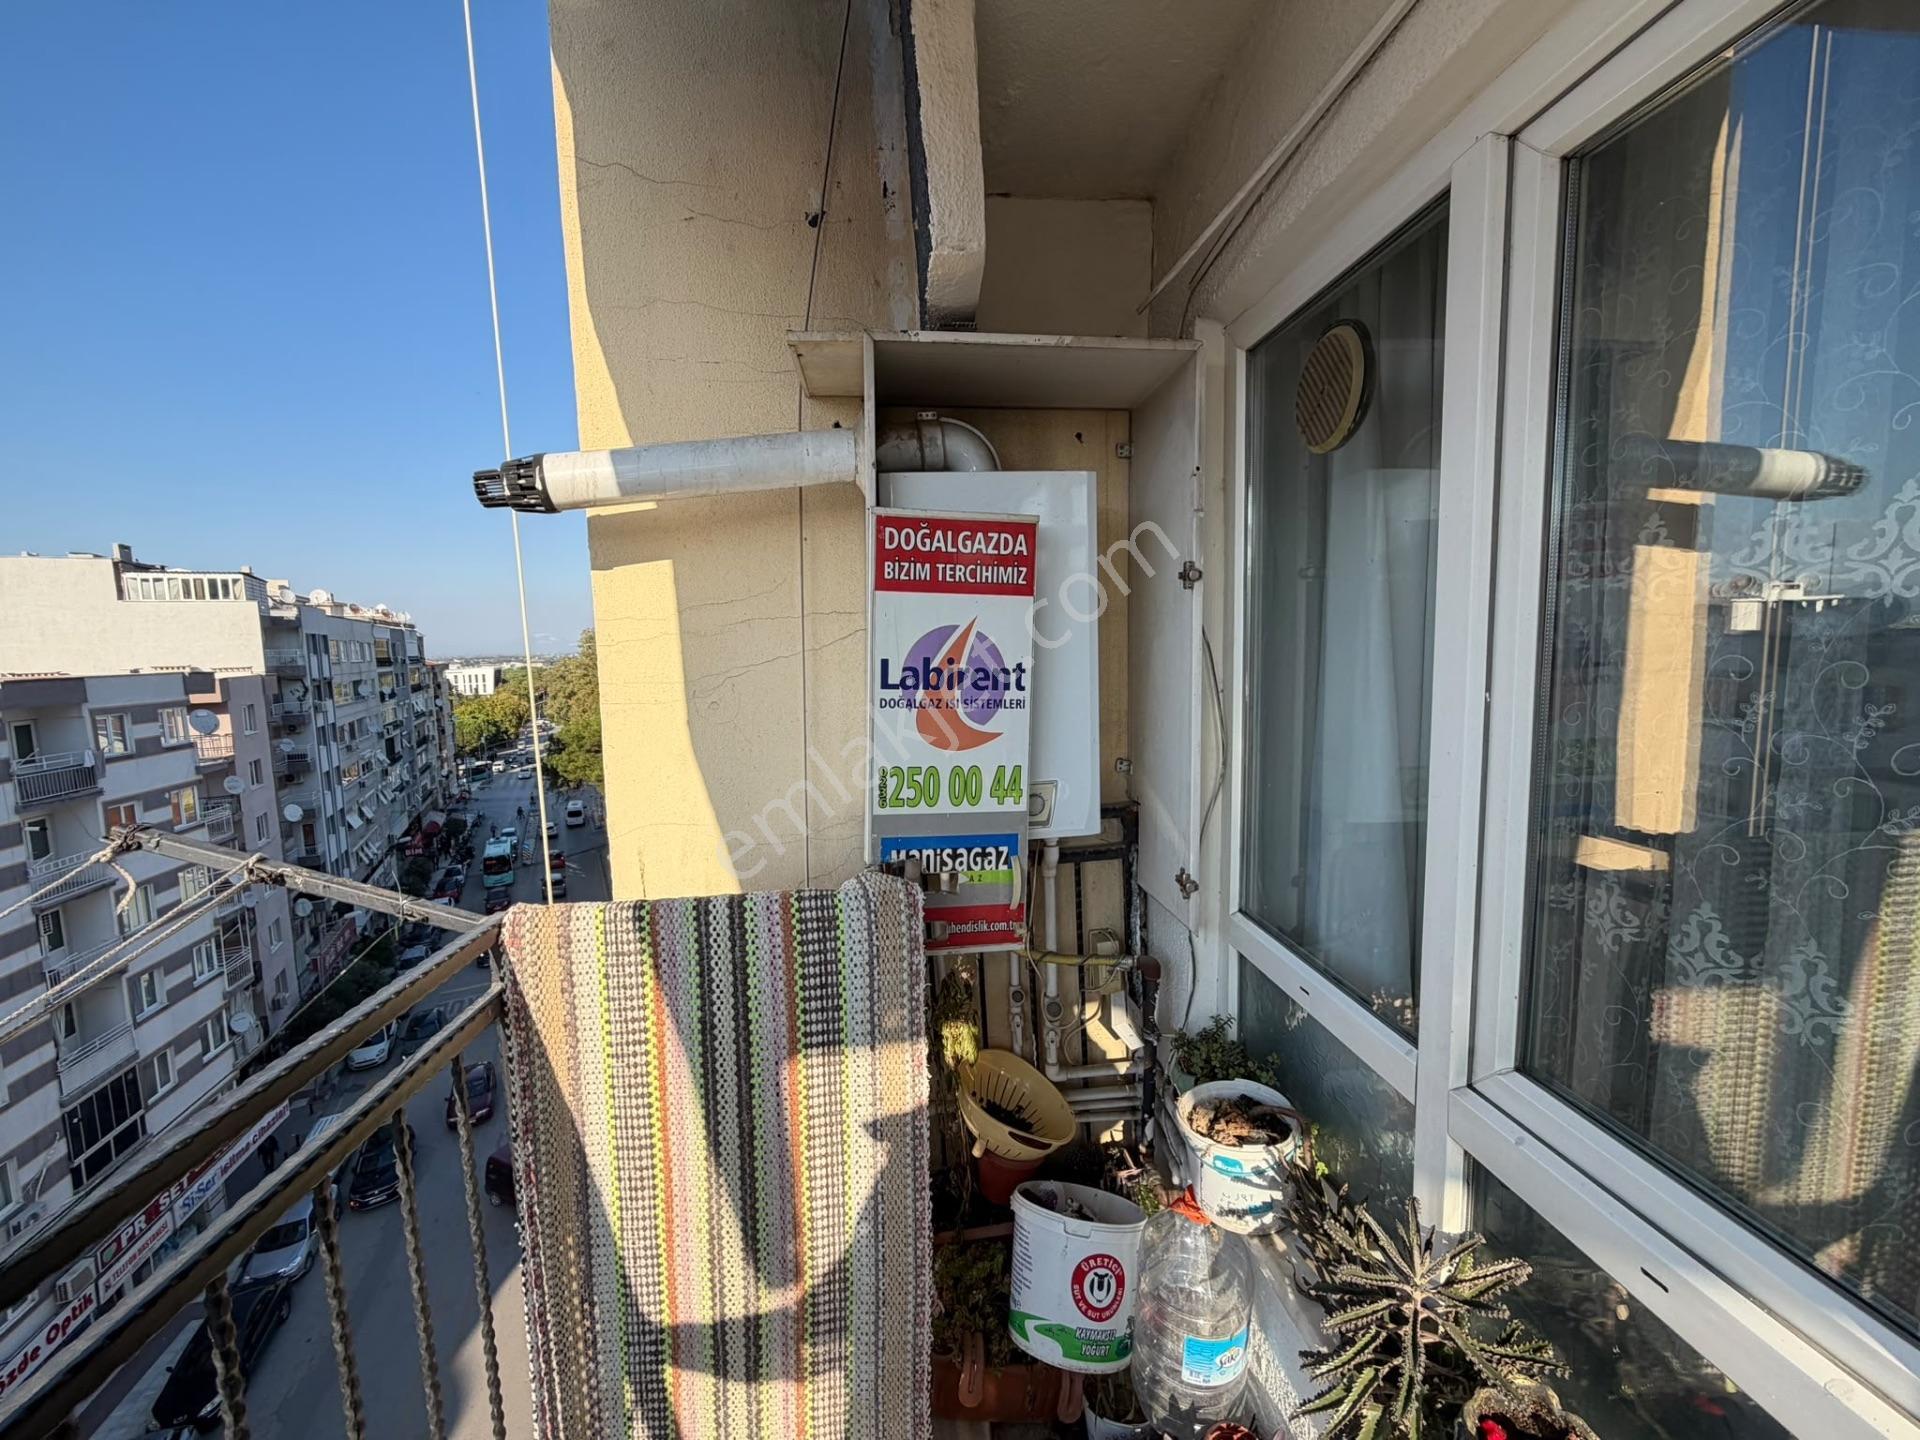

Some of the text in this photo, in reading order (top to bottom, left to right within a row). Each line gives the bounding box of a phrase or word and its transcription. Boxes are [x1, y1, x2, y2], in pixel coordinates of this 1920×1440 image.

[884, 522, 1028, 555] DOĞALGAZDA
[884, 557, 1027, 584] BİZİM TERCİHİMİZ
[880, 657, 1026, 691] Labirent
[880, 695, 942, 712] DOĞALGAZ
[963, 697, 1026, 710] SİSTEMLERİ
[889, 765, 940, 808] 250
[949, 765, 983, 807] 00
[990, 765, 1023, 805] 44
[46, 1292, 94, 1345] Optik
[1081, 1343, 1111, 1357] YOĞURT
